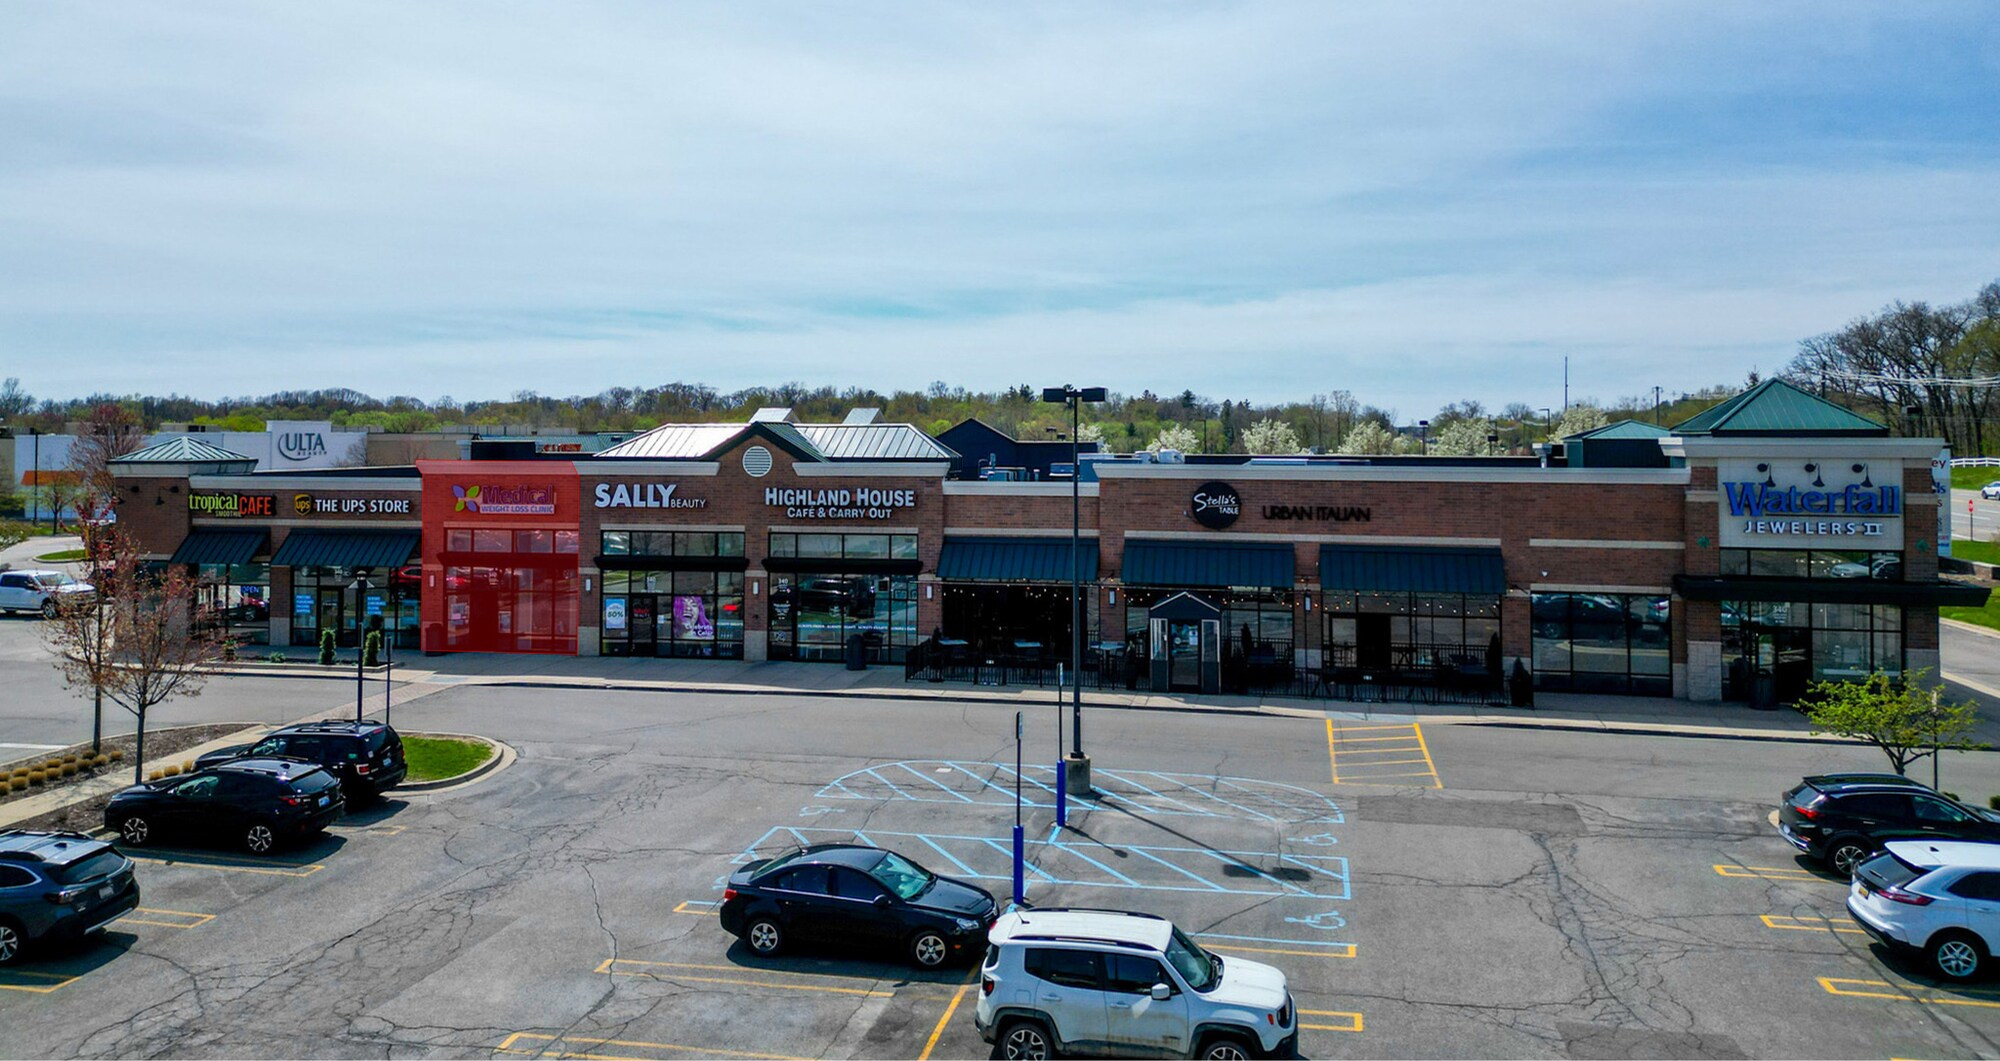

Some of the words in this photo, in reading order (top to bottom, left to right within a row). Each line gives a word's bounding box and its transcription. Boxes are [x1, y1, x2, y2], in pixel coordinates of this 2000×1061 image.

[285, 432, 325, 451] ULTA
[481, 484, 554, 505] Medical
[594, 483, 677, 508] SALLY
[765, 487, 851, 506] HIGHLAND
[856, 488, 915, 507] HOUSE
[1193, 493, 1236, 512] Stella's
[1722, 482, 1902, 517] Waterfall
[188, 493, 238, 513] tropical
[239, 496, 272, 515] CAFE
[315, 499, 338, 512] THE
[342, 499, 366, 512] UPS
[370, 500, 409, 513] STORE
[530, 505, 553, 513] CLINIC
[670, 499, 706, 508] BEAUTY
[1219, 507, 1239, 515] TABLE
[817, 508, 826, 518] &
[828, 507, 866, 518] CARRY
[868, 508, 892, 518] OUT
[1262, 506, 1312, 521] URBAN
[1316, 506, 1371, 522] ITALIAN
[1744, 521, 1856, 535] JEWELERS
